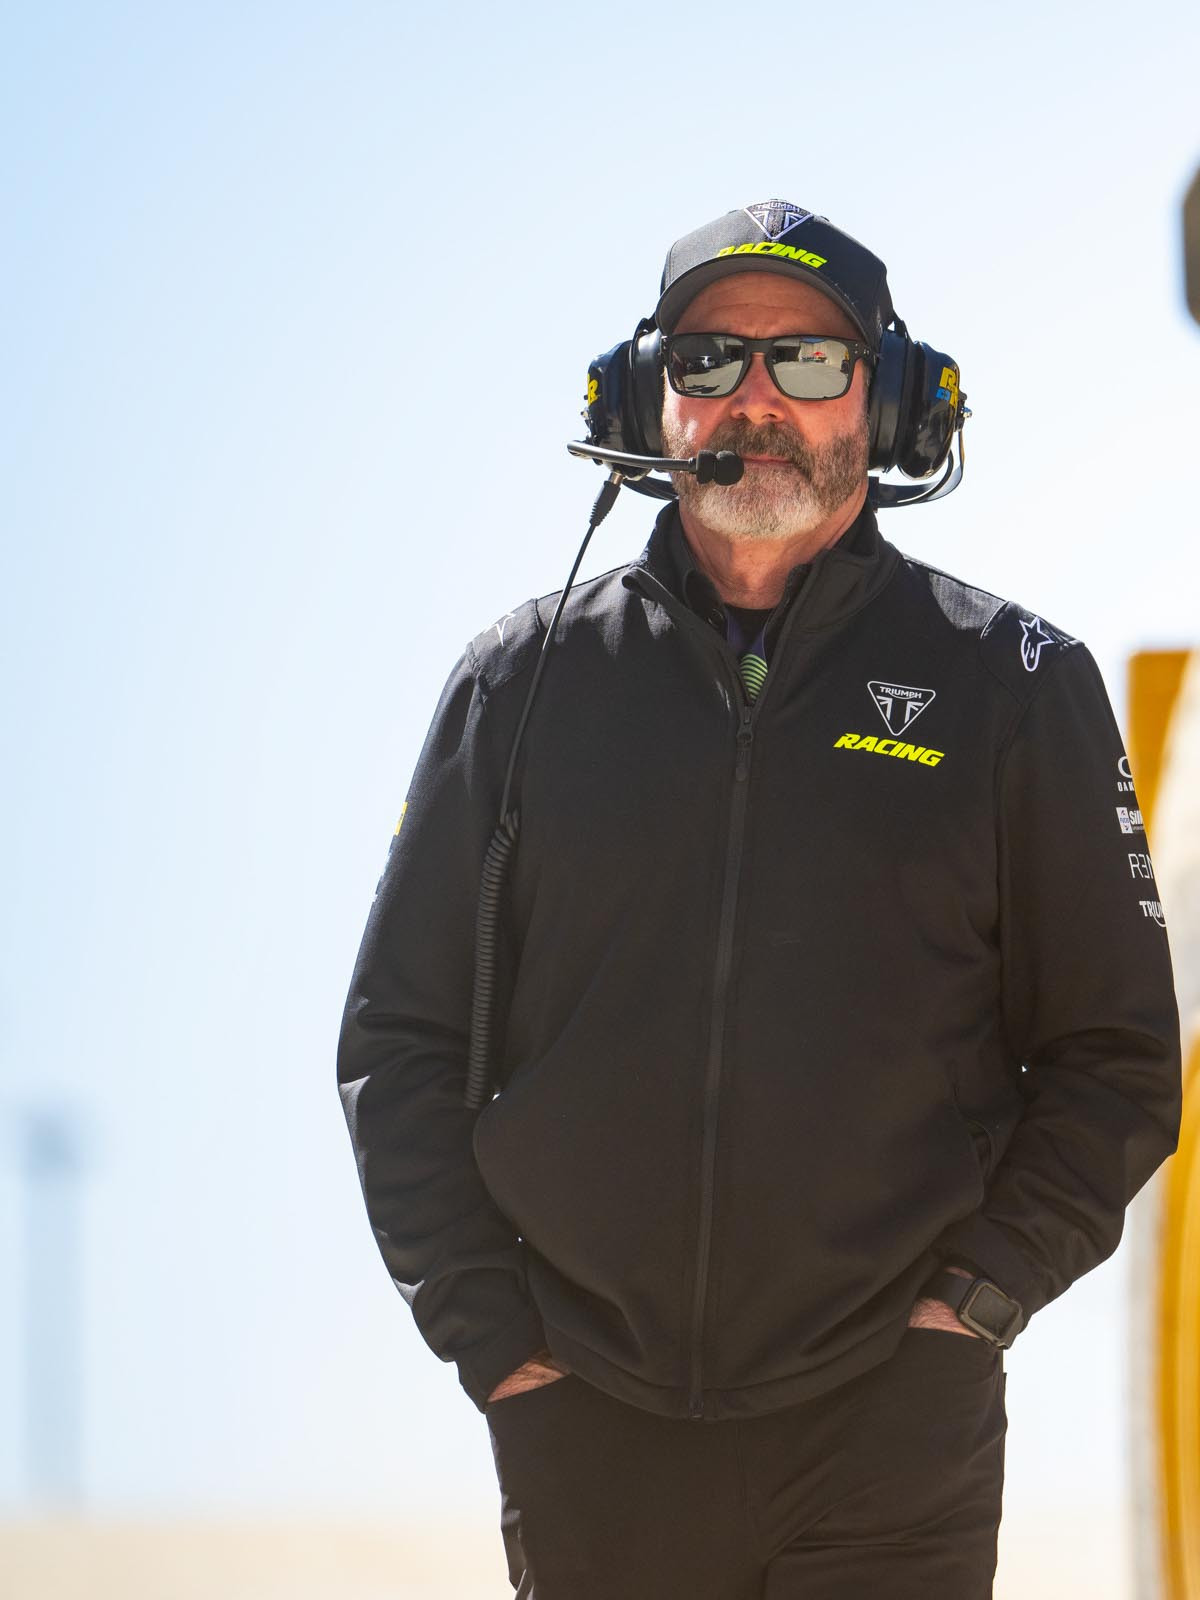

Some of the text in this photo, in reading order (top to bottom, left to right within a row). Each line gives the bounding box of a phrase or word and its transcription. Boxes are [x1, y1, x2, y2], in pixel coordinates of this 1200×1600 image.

[716, 241, 828, 269] RACING
[879, 685, 922, 699] TRIUMPH
[833, 732, 945, 767] RACING
